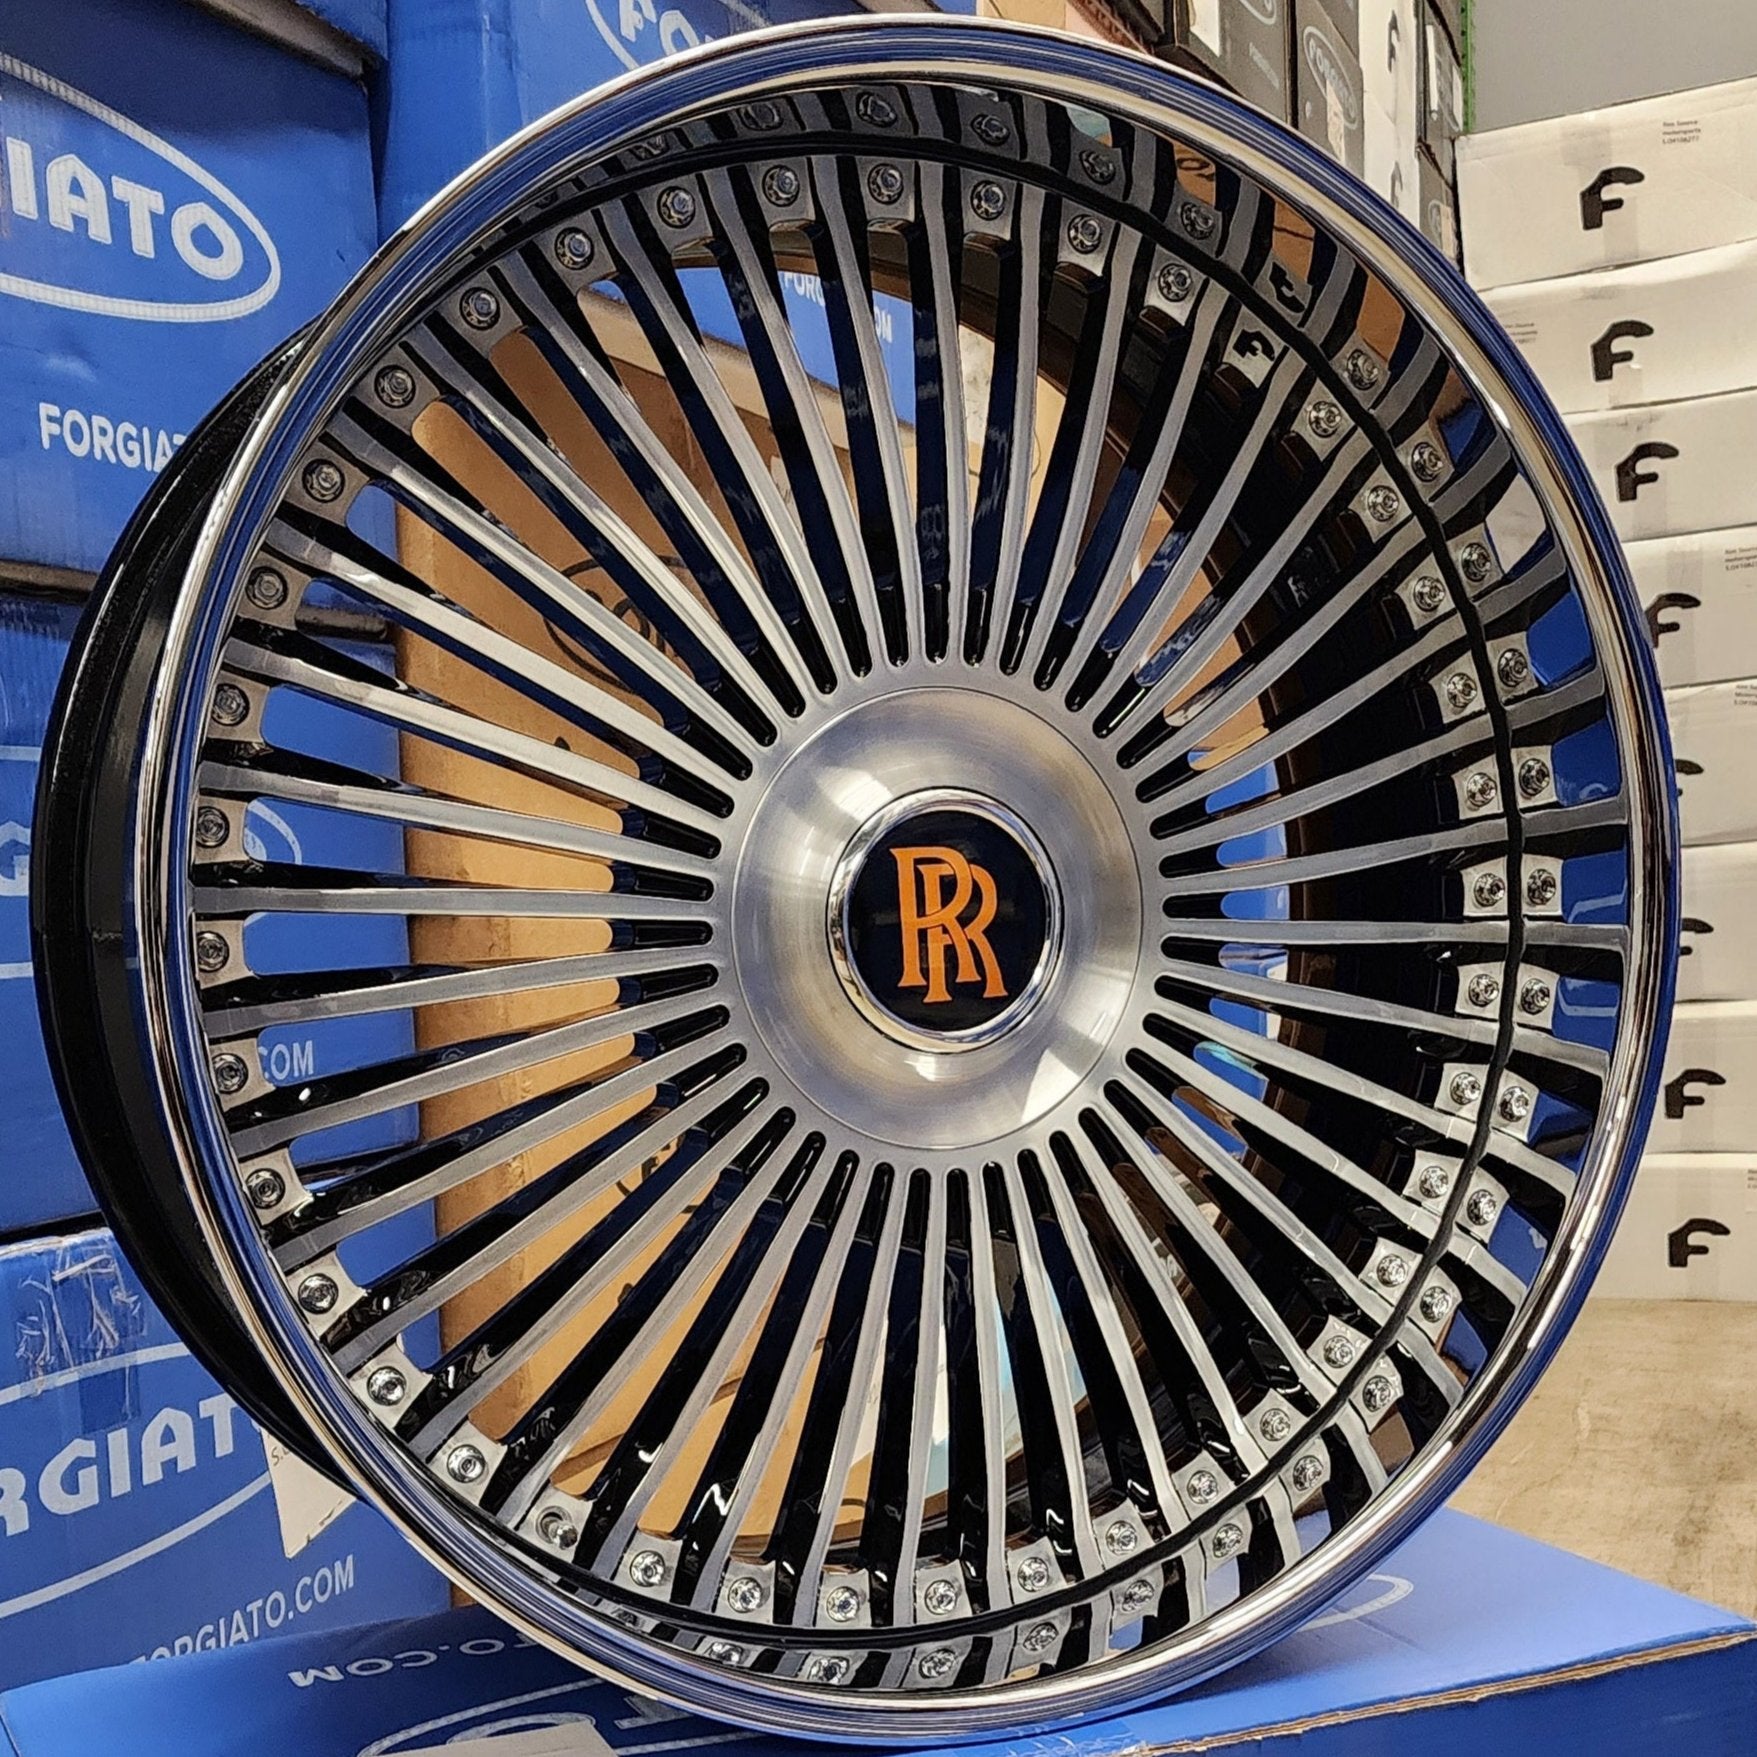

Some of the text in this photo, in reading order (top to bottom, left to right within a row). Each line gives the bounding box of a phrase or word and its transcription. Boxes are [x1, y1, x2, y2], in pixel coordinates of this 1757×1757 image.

[1579, 166, 1645, 231] F
[1590, 320, 1654, 383] F
[38, 401, 188, 473] FORGIA
[1615, 441, 1679, 502] F
[889, 846, 1009, 1004] RR
[1664, 1068, 1727, 1119] F
[1668, 1218, 1731, 1268] F
[0, 1393, 261, 1517] RGIAT
